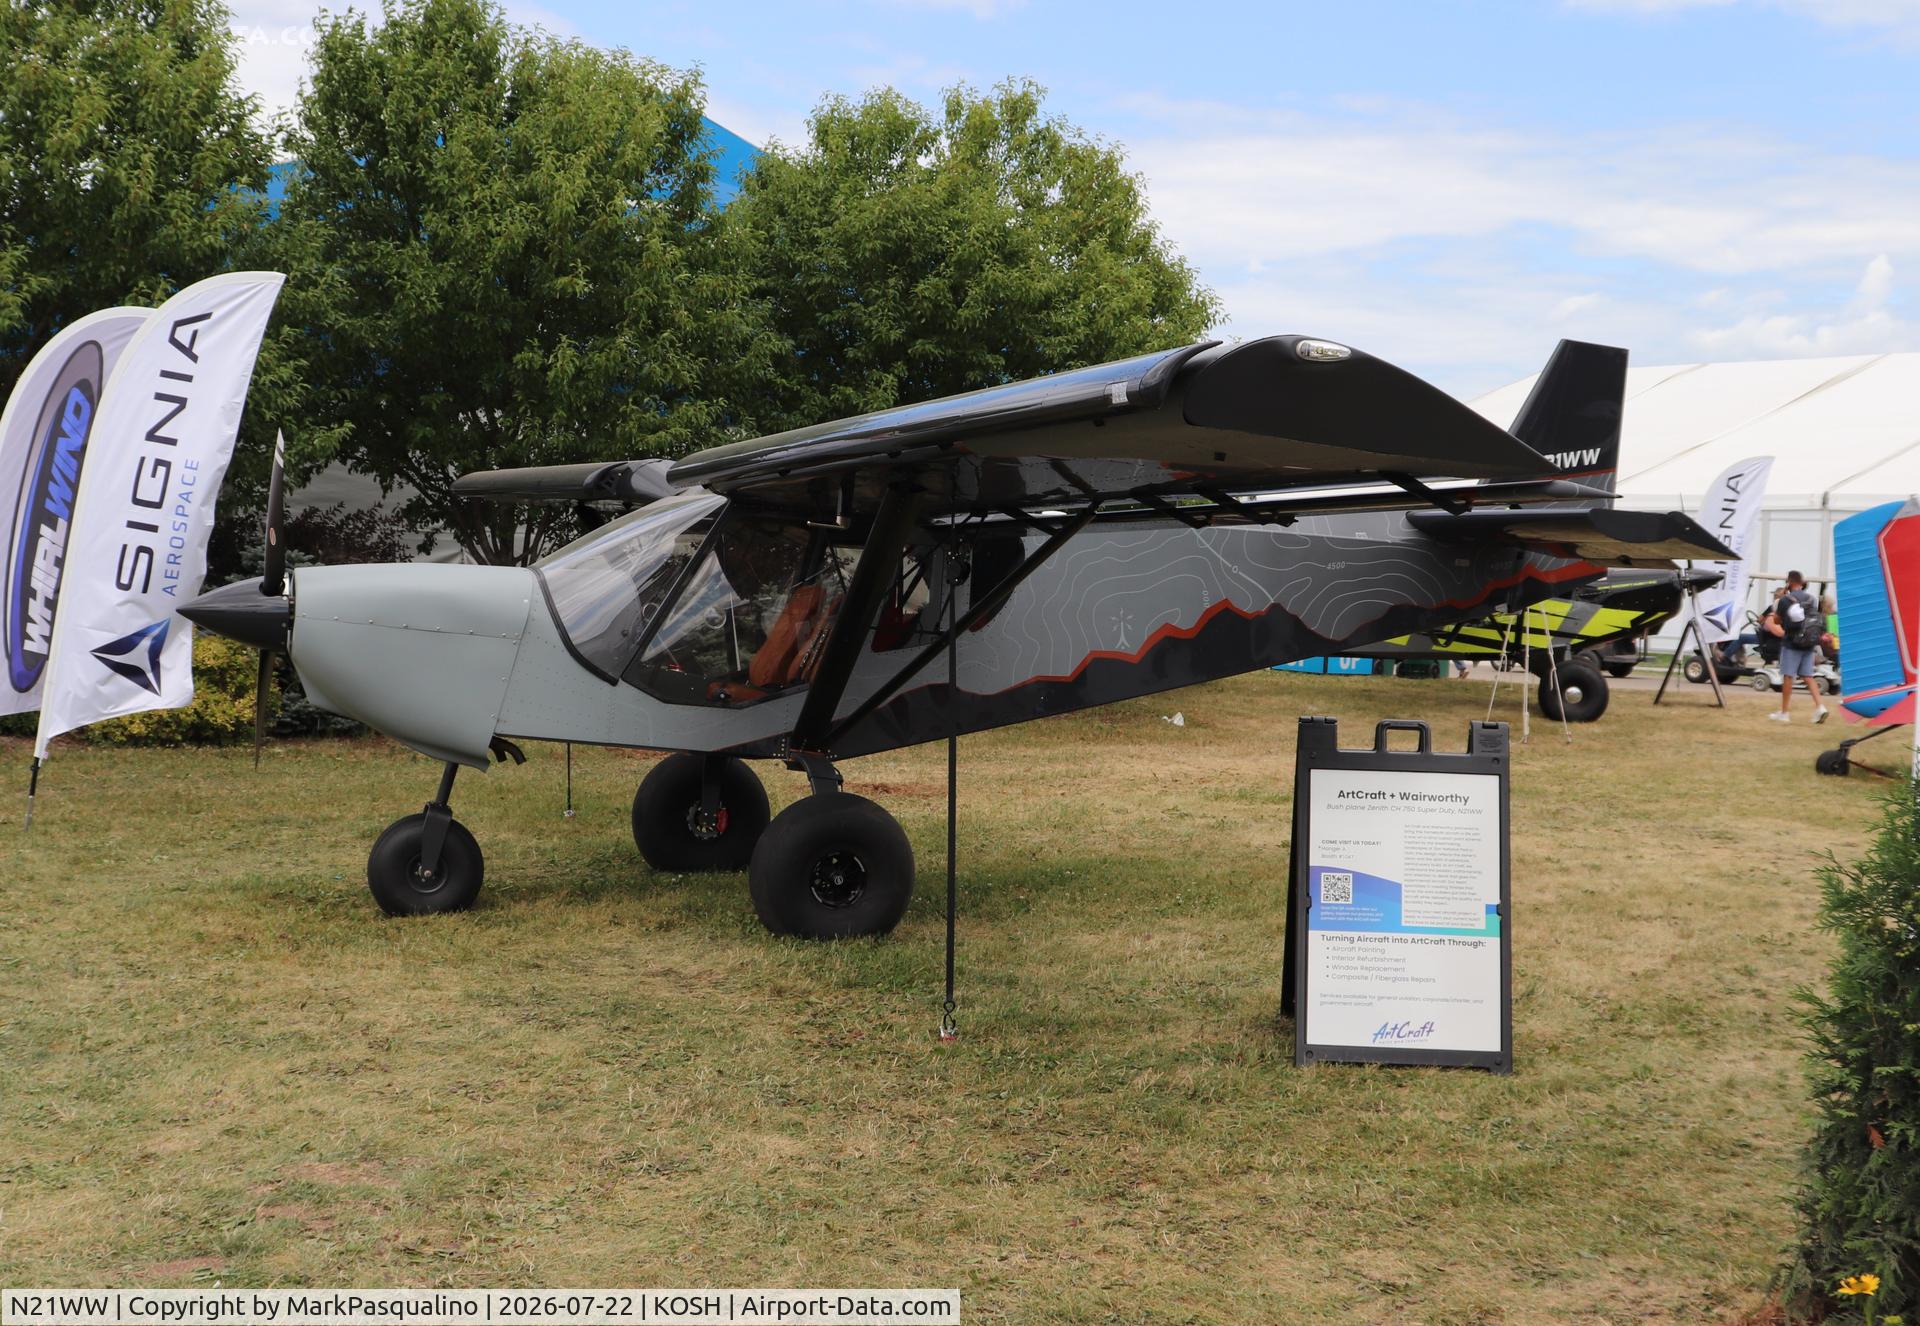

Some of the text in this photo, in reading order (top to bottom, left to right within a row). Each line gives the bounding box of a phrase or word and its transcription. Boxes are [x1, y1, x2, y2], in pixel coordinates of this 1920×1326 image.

[116, 312, 213, 593] SIGNIA
[23, 387, 90, 655] WHIRLWIND
[162, 459, 199, 597] AEROSPACE
[1338, 790, 1386, 800] ArtCraft
[1400, 792, 1469, 806] Wairworthy
[1321, 934, 1486, 949] Turning Aircraft into ArtCraft Through:
[1358, 946, 1385, 954] Painting
[1375, 974, 1409, 982] Fiberglass
[1372, 1020, 1435, 1044] ArtCraft
